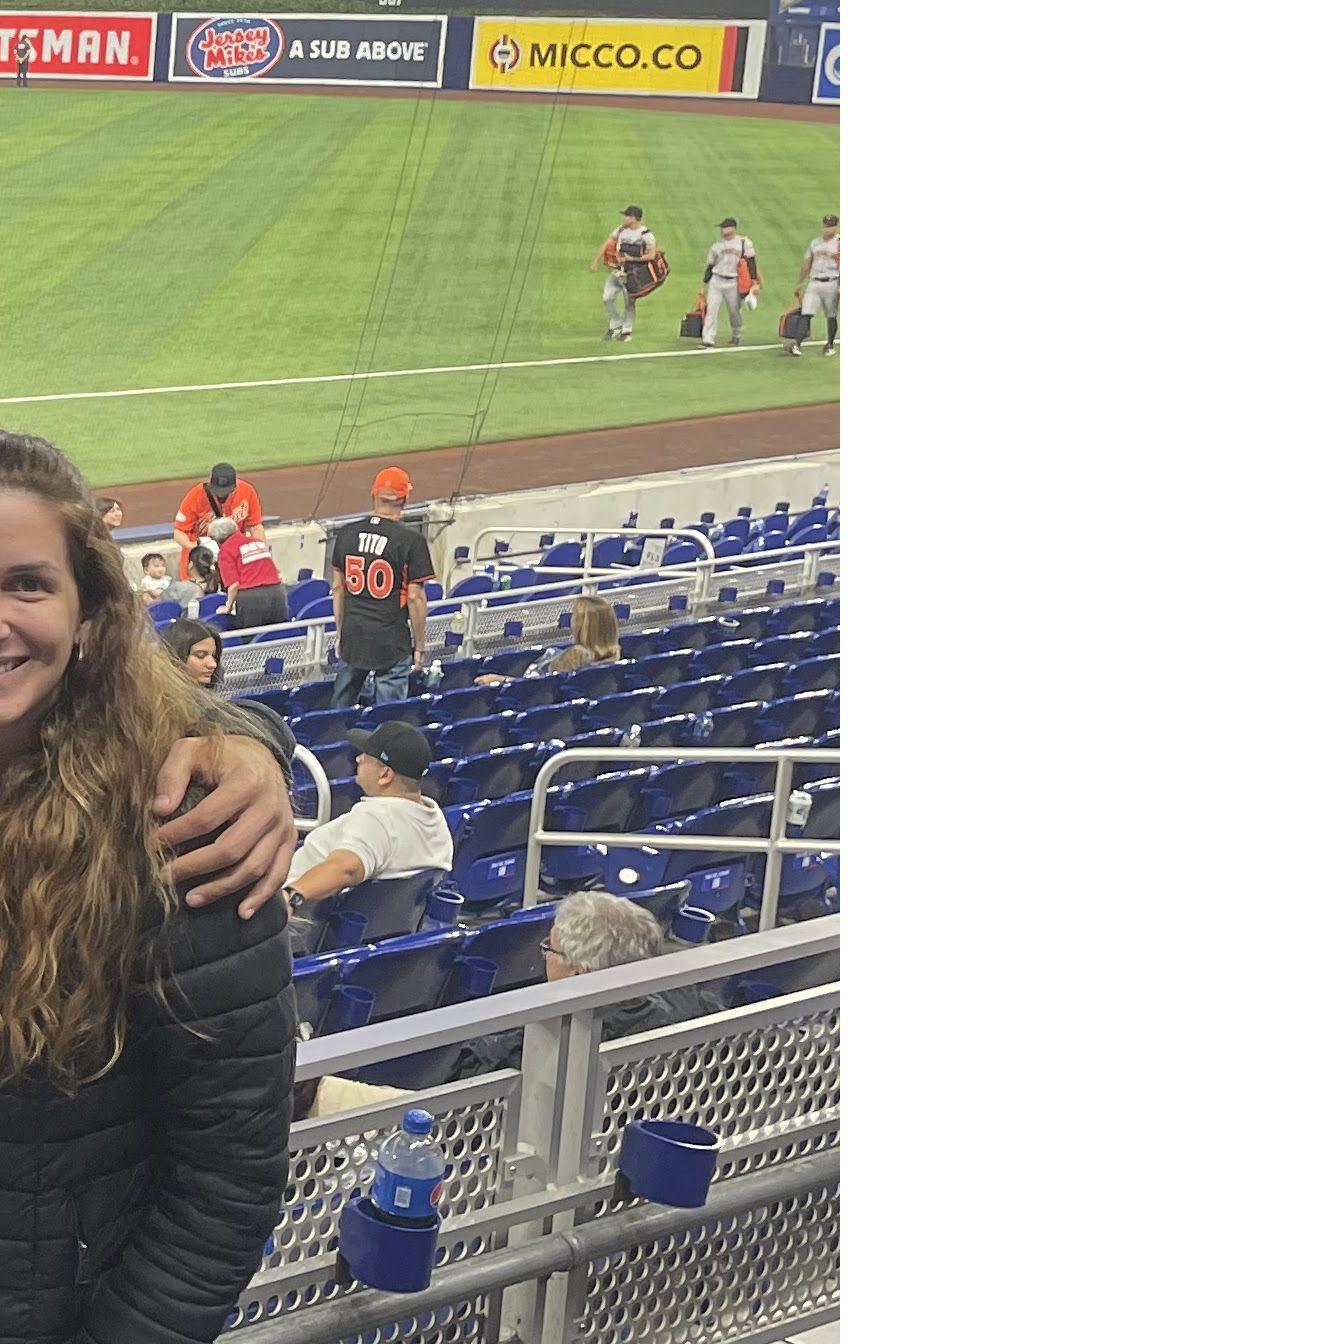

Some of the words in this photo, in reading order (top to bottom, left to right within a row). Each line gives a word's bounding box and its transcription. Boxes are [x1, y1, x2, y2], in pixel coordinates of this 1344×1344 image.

[198, 27, 271, 51] Jersey
[289, 40, 305, 59] A
[310, 40, 351, 59] SUB
[356, 41, 425, 62] ABOVE
[529, 43, 702, 70] MICCO.CO
[358, 532, 388, 555] TITO
[345, 555, 394, 599] 50
